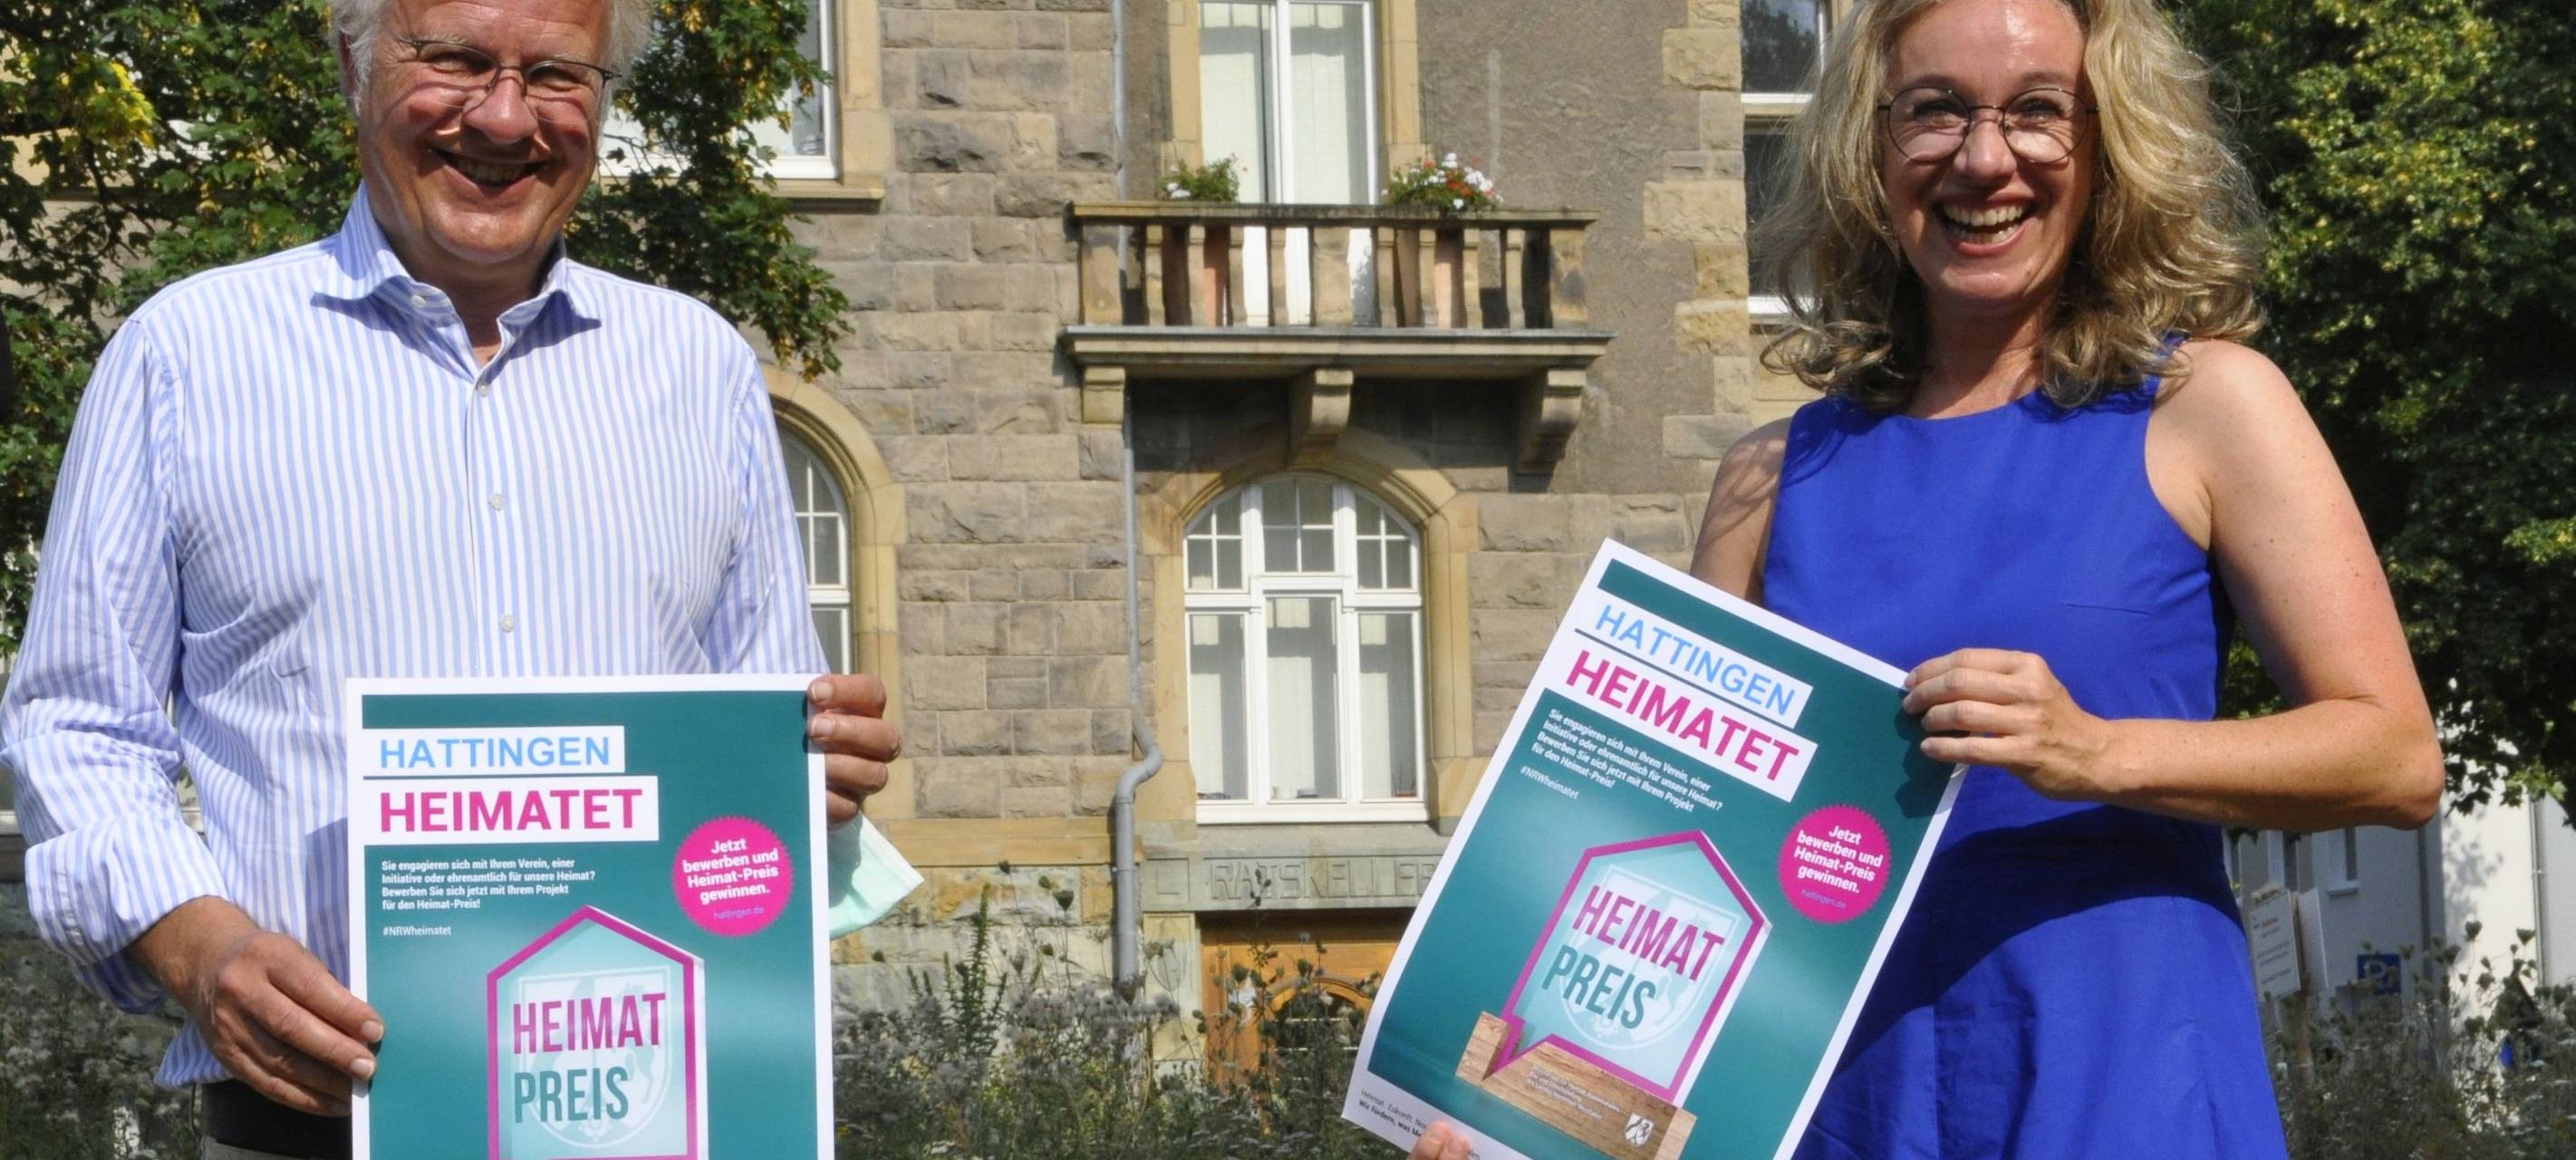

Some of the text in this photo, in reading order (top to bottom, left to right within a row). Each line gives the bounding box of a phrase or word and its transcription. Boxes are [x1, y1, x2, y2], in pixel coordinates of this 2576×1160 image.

[1595, 604, 1796, 716] HATTINGEN
[1566, 649, 1799, 781] HEIMATET
[380, 736, 610, 768] HATTINGEN
[1531, 742, 1616, 788] für den Heimat-Preis!
[1542, 720, 1723, 811] Initiative oder ehrenamtlich für unsere Heimat?
[1548, 708, 1712, 791] Sie engagieren sich mit Ihrem Verein, einer
[1520, 766, 1579, 800] #NRWheimatet
[1537, 730, 1694, 813] Bewerben Sie sich jetzt mit Ihrem Projekt
[380, 788, 643, 833] HEIMATET
[710, 837, 747, 854] Jetzt
[1797, 828, 1884, 868] bewerben und
[1828, 825, 1862, 845] Jetzt
[381, 858, 574, 873] Sie engagieren sich mit Ihrem Verein, einer
[381, 870, 596, 884] Initiative oder ehrenamtlich für unsere Heimat?
[682, 847, 779, 874] bewerben und
[687, 865, 779, 888] Heimat-Preis
[1794, 846, 1876, 882] Heimat-Preis
[382, 884, 569, 898] Bewerben Sie sich jetzt mit Ihrem Projekt
[699, 884, 771, 906] gewinnen.
[1798, 865, 1860, 894] gewinnen.
[382, 898, 481, 910] für den Heimat-Preis!
[382, 926, 451, 937] #NRWheimatet
[1571, 884, 1725, 983] HEIMAT
[1541, 944, 1657, 1030] PREIS
[513, 991, 666, 1055] HEIMAT
[515, 1066, 629, 1124] PREIS
